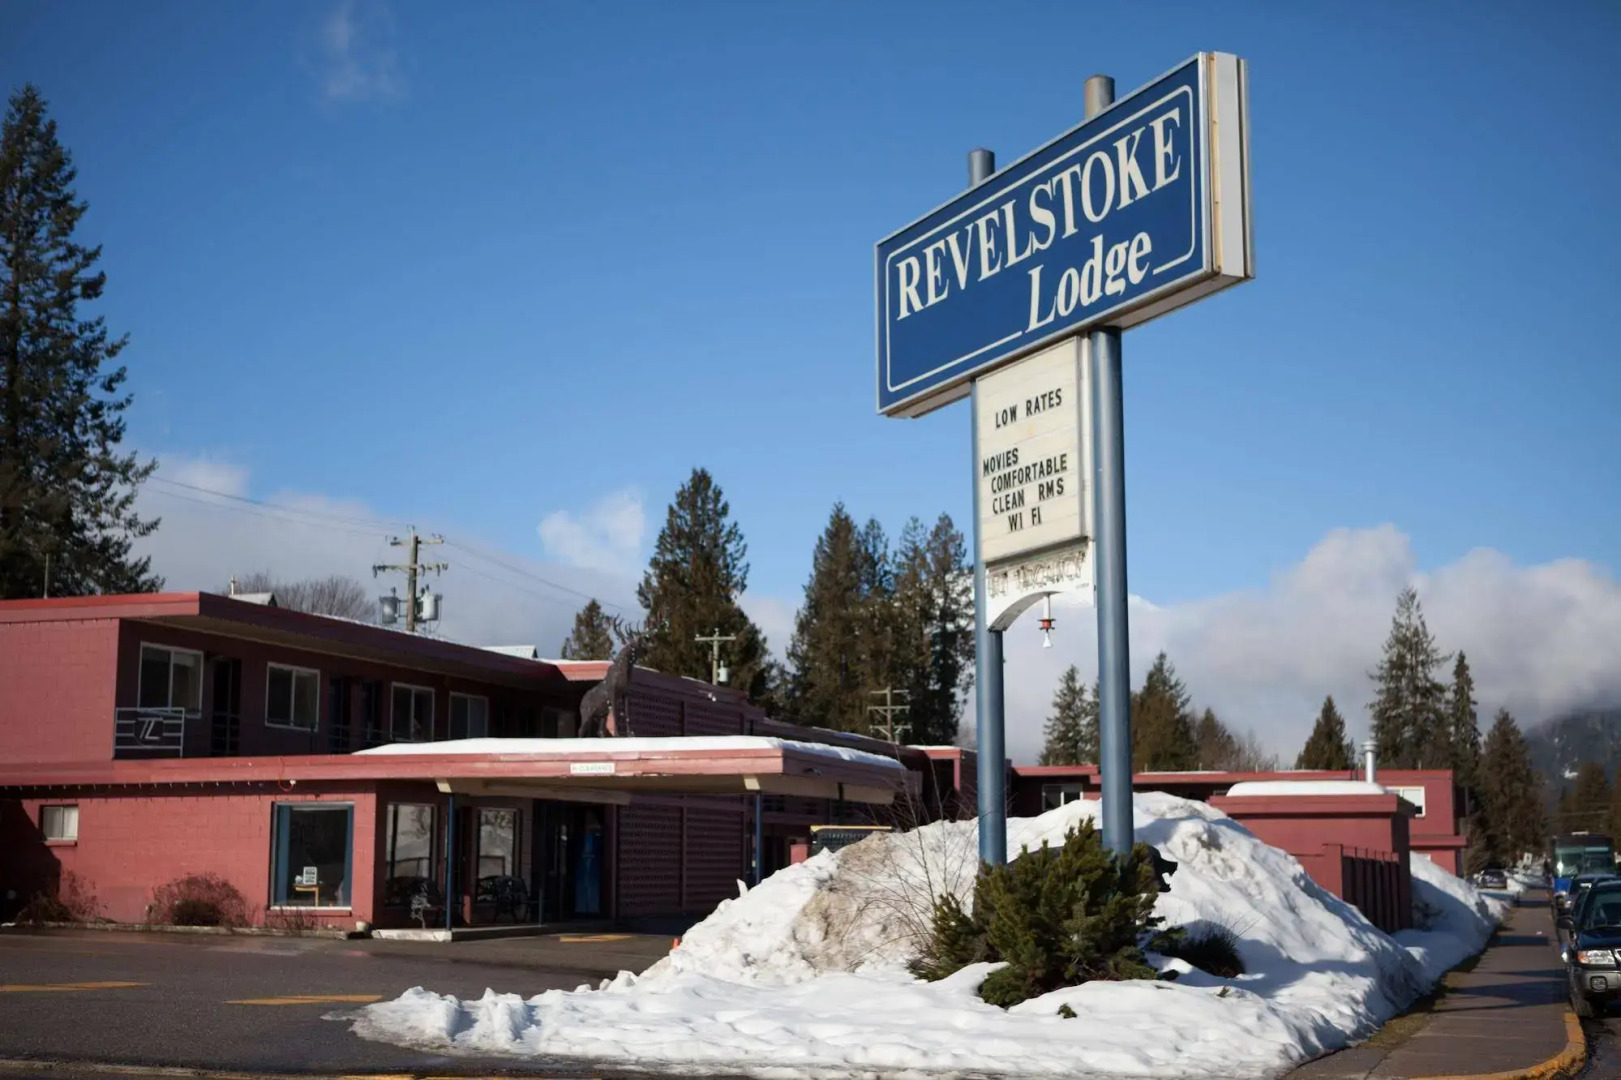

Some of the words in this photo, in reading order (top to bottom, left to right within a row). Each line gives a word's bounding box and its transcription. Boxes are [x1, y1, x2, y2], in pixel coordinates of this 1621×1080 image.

[896, 107, 1181, 321] REVELSTOKE
[1024, 231, 1152, 334] Lodge
[995, 404, 1018, 429] LOW
[1026, 388, 1062, 417] RATES
[983, 447, 1019, 477] MOVIES
[991, 453, 1068, 494] COMFORTABLE
[992, 489, 1025, 515] CLEAN
[1038, 477, 1064, 501] RMS
[1008, 512, 1023, 532] WI
[1031, 506, 1042, 526] FI
